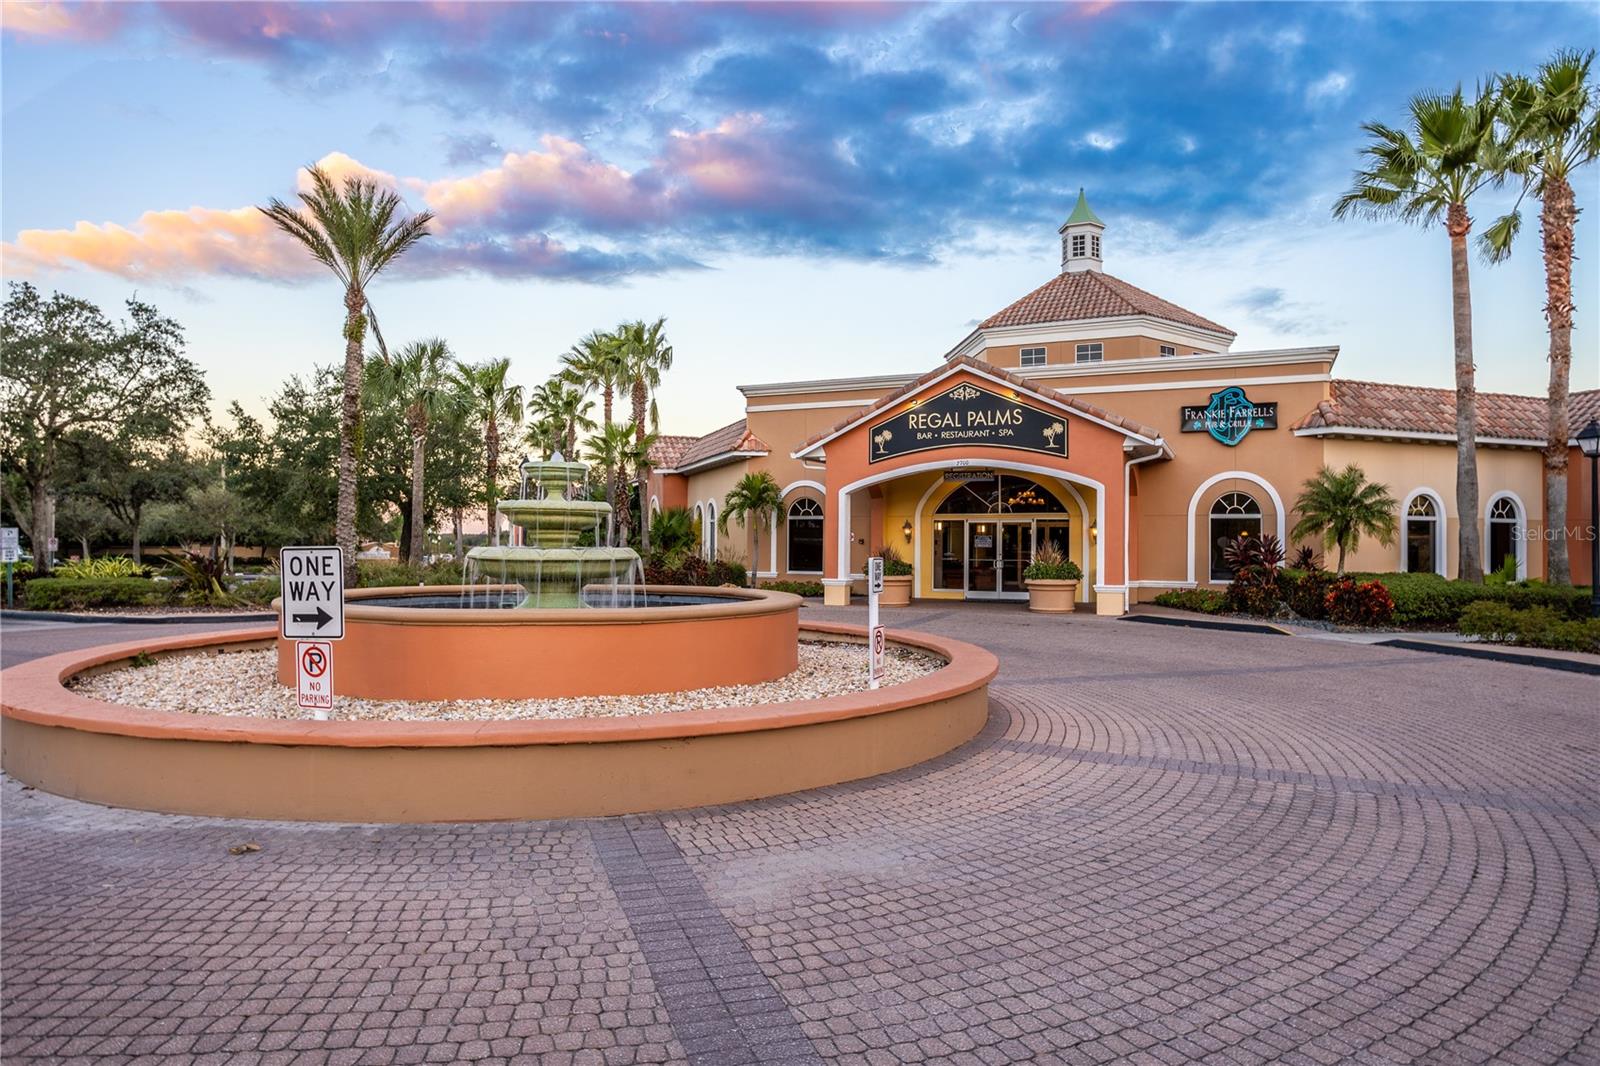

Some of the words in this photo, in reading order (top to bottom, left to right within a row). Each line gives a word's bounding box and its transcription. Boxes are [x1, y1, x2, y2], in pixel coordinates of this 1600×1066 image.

[908, 412, 962, 430] REGAL
[967, 408, 1023, 427] PALMS
[1185, 408, 1226, 420] FRANKIE
[1229, 406, 1274, 418] FARRELLS
[1204, 421, 1217, 429] PB
[917, 432, 933, 440] BAR
[941, 429, 990, 439] RESTAURANT
[998, 428, 1014, 437] SPA
[289, 556, 334, 576] ONE
[289, 580, 335, 601] WAY
[309, 682, 321, 692] NO
[301, 693, 330, 705] PARKING
